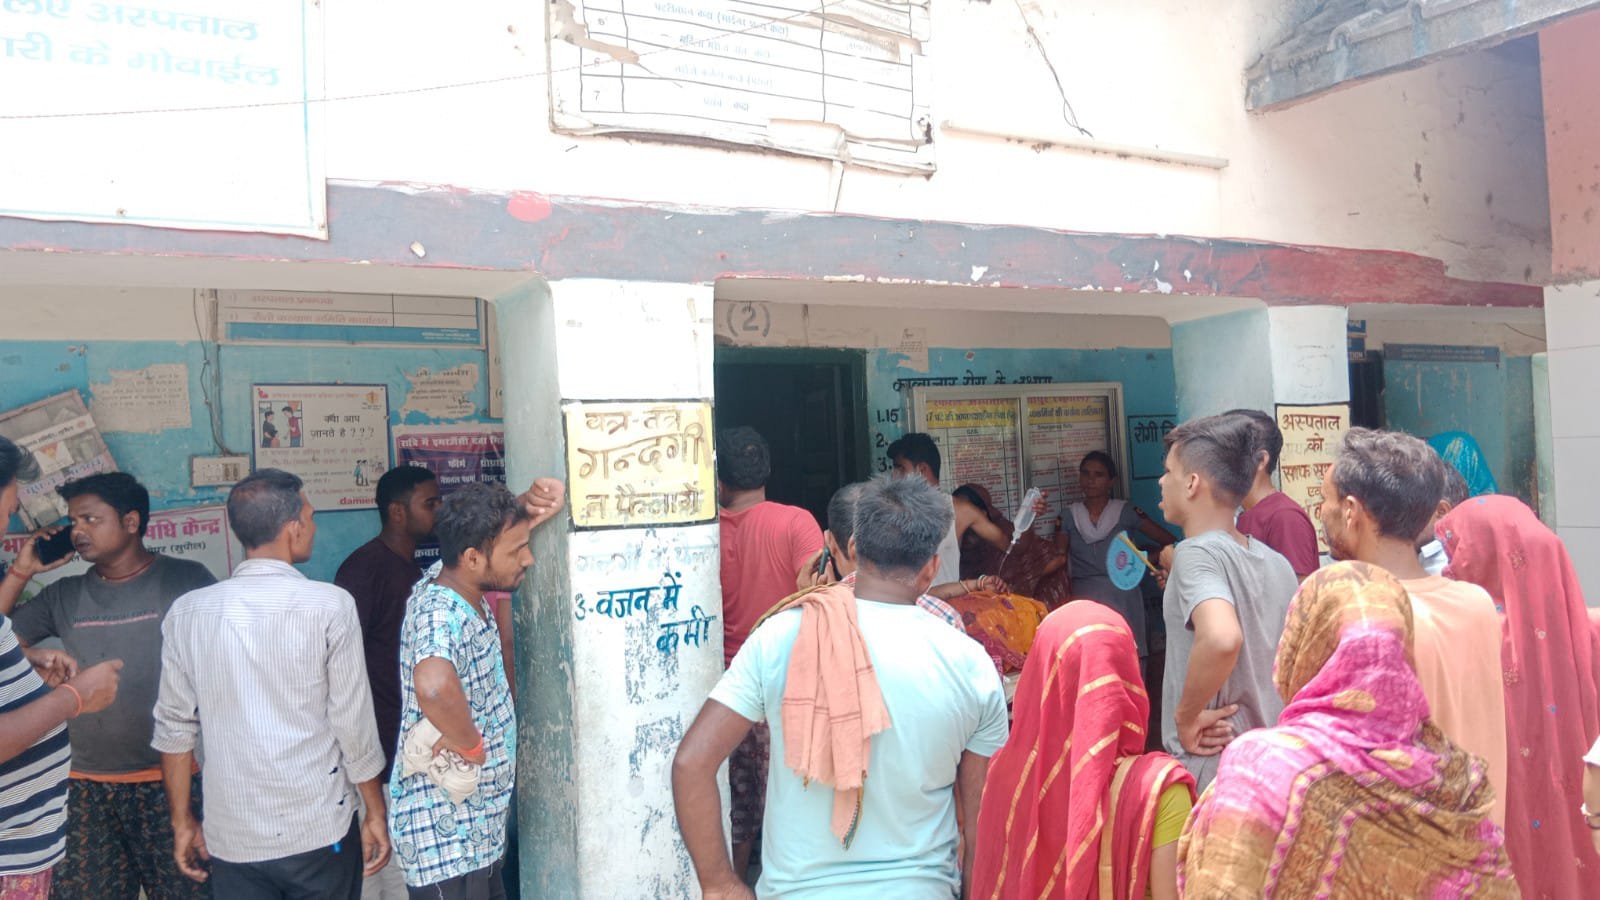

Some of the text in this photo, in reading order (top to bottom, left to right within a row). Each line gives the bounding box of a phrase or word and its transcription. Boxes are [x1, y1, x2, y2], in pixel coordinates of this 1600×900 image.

[85, 2, 260, 41] अस्पताल
[0, 31, 53, 62] ारी
[726, 303, 770, 337] (2)
[343, 414, 360, 423] आप
[1281, 413, 1341, 431] अस्पताल
[310, 427, 335, 438] जानते
[1133, 420, 1159, 444] रोगी
[1306, 433, 1324, 452] को
[577, 422, 706, 480] गन्दगी
[1281, 464, 1310, 483] साफ
[586, 493, 609, 519] न
[182, 516, 220, 537] केन्द्र
[3, 536, 28, 553] भा
[662, 571, 683, 611] में
[656, 604, 717, 654] कमी
